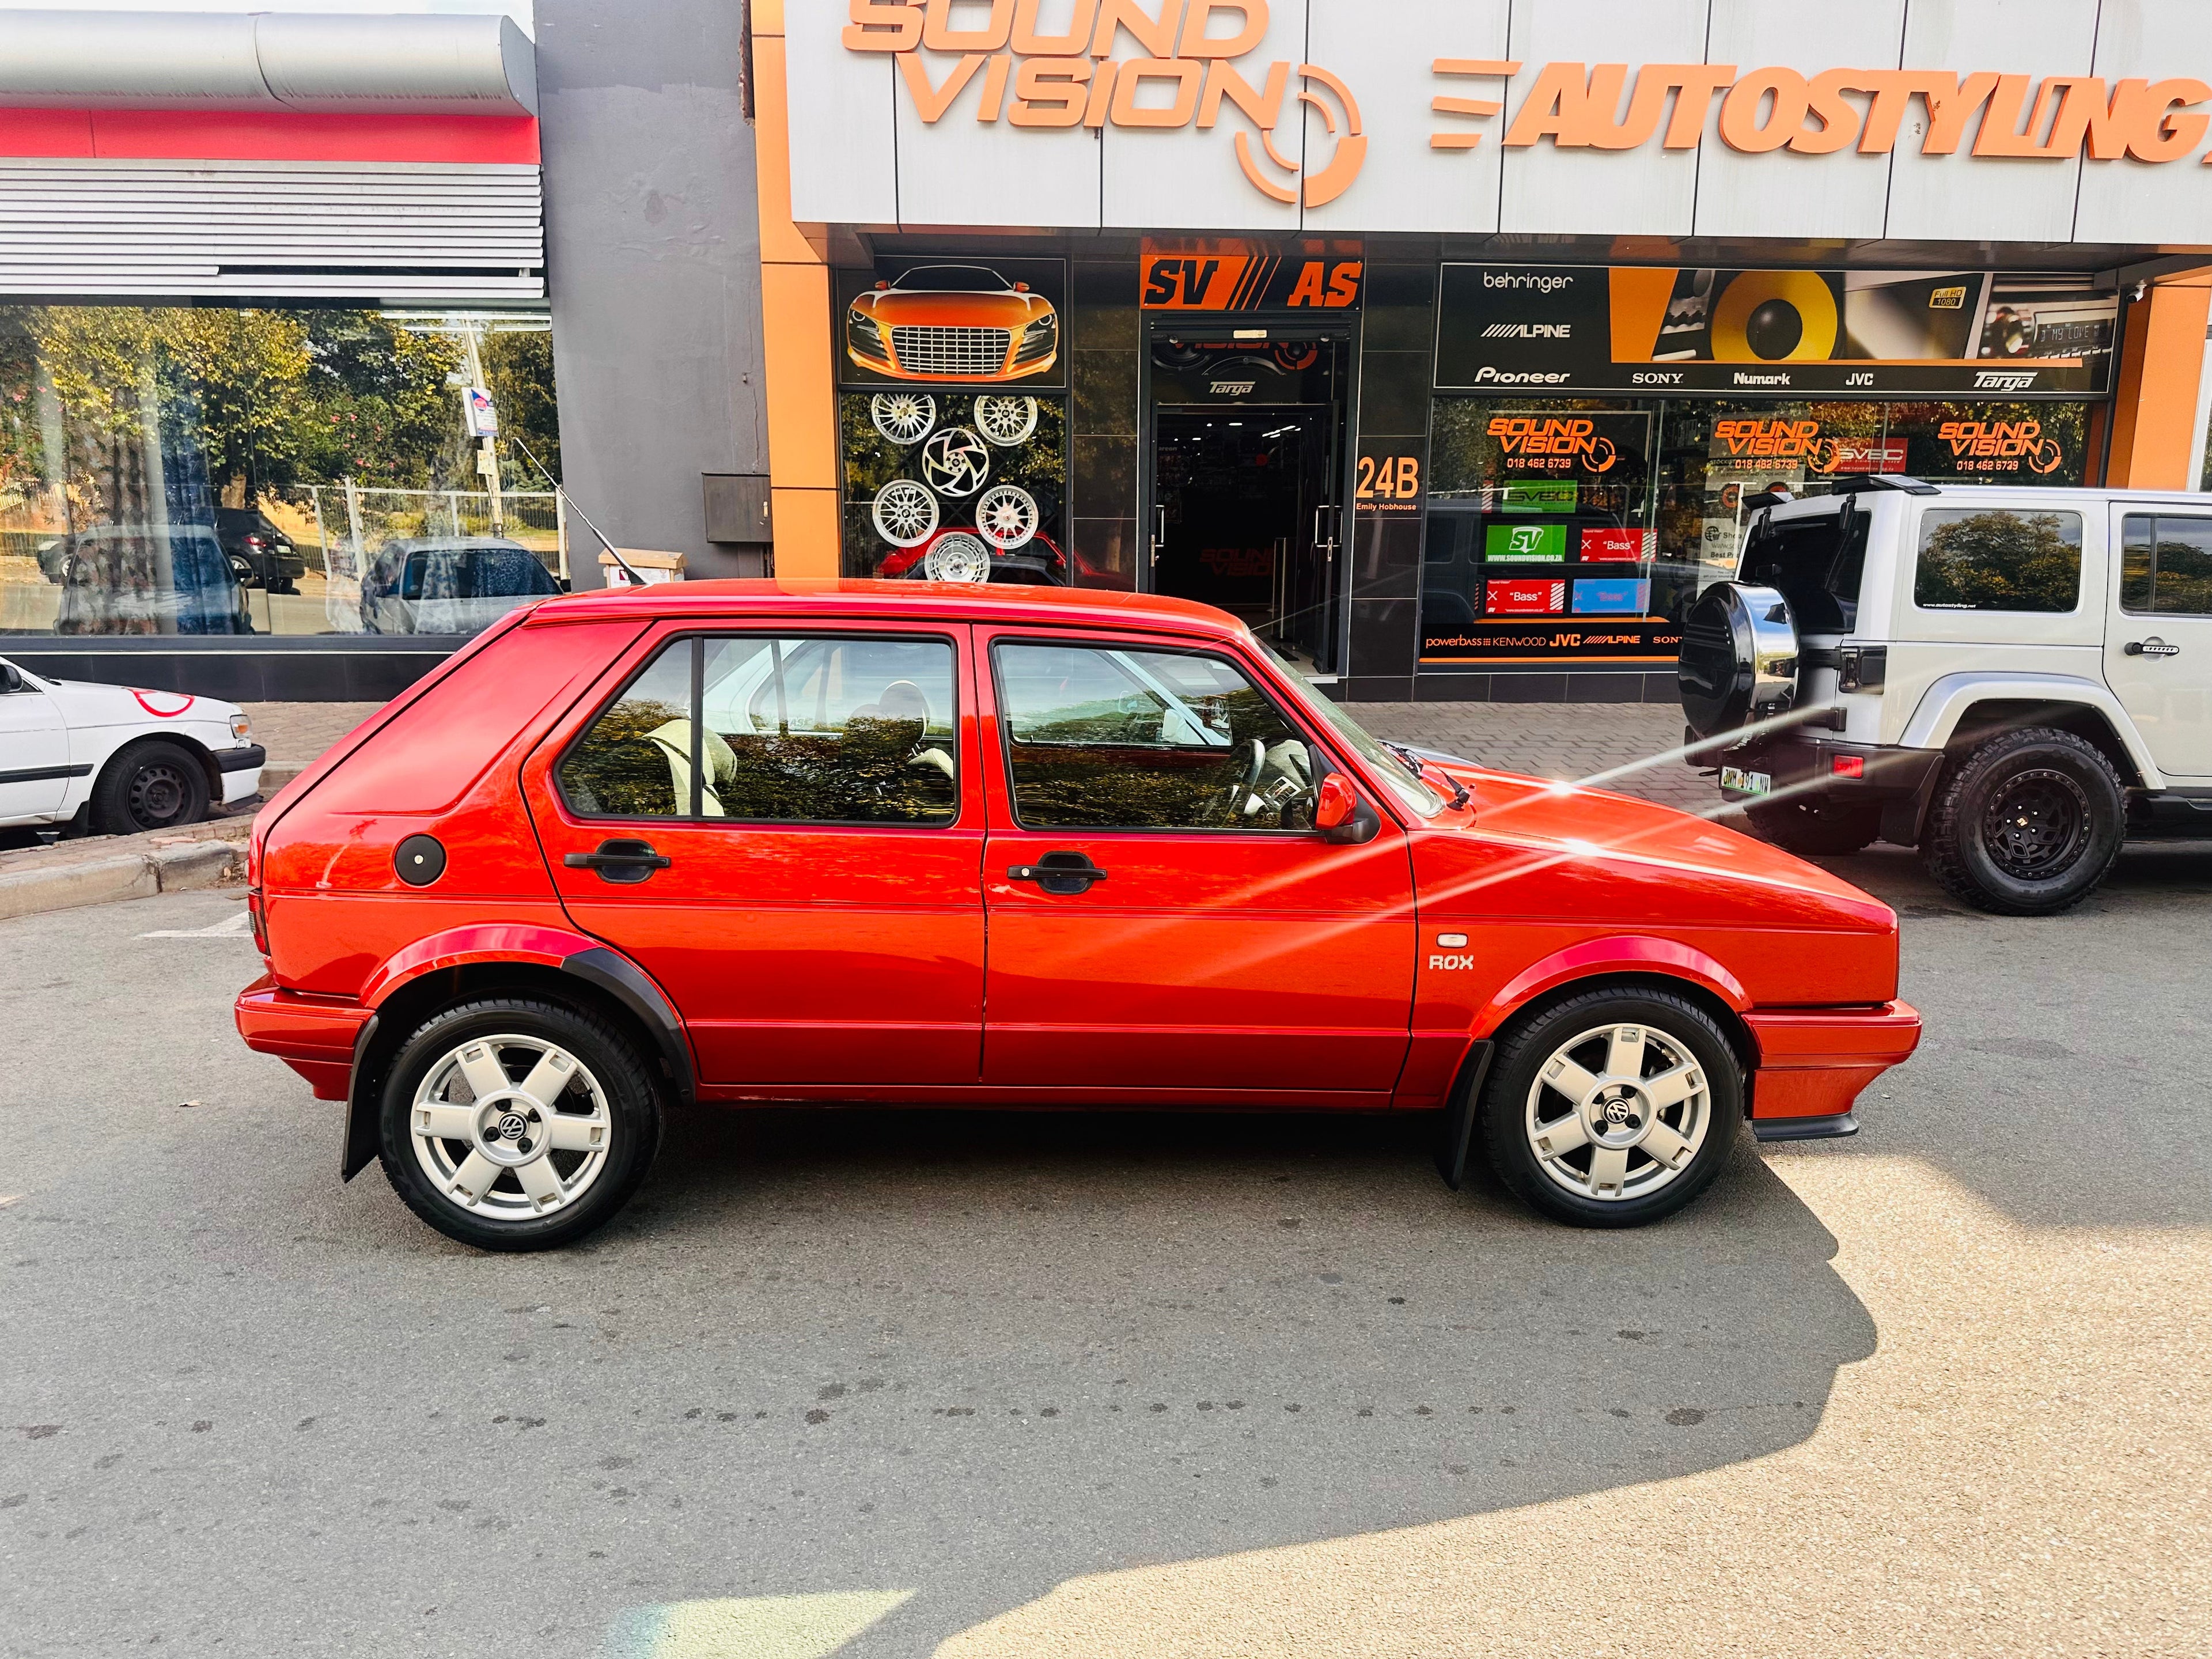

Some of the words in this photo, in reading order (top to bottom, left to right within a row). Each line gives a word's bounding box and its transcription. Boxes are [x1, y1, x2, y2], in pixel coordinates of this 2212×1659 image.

[842, 0, 1268, 59] SOUND
[896, 52, 1290, 130] VISION
[1502, 62, 2212, 163] AUTOSTYLING
[1143, 259, 1219, 305] SV
[1287, 262, 1363, 307] AS
[1483, 272, 1574, 294] behringer
[1475, 366, 1570, 384] Pioneer
[1632, 373, 1682, 384] SONY
[1733, 372, 1791, 385] Numark
[1845, 373, 1874, 386] JVC
[1973, 372, 2039, 392] Targa
[1209, 381, 1256, 396] Targa
[1487, 418, 1594, 437] SOUND
[1715, 421, 1819, 438] SOUND
[1937, 422, 2041, 440] SOUND
[1500, 435, 1597, 454] VISION
[1728, 438, 1823, 455] VISION
[1950, 438, 2044, 456] VISION
[1507, 458, 1525, 468] 018
[1527, 458, 1545, 468] 462
[1548, 458, 1571, 468] 6739
[1735, 459, 1753, 469] 018
[1755, 459, 1772, 469] 462
[1774, 459, 1798, 469] 6739
[1956, 460, 1974, 471] 018
[1976, 460, 1993, 471] 462
[1356, 456, 1419, 499] 24B
[1356, 503, 1377, 512] Emily
[1509, 530, 1544, 550] SV
[1493, 637, 1547, 646] KENWOOD
[1549, 634, 1581, 647] JVC
[1429, 955, 1474, 970] ROX
